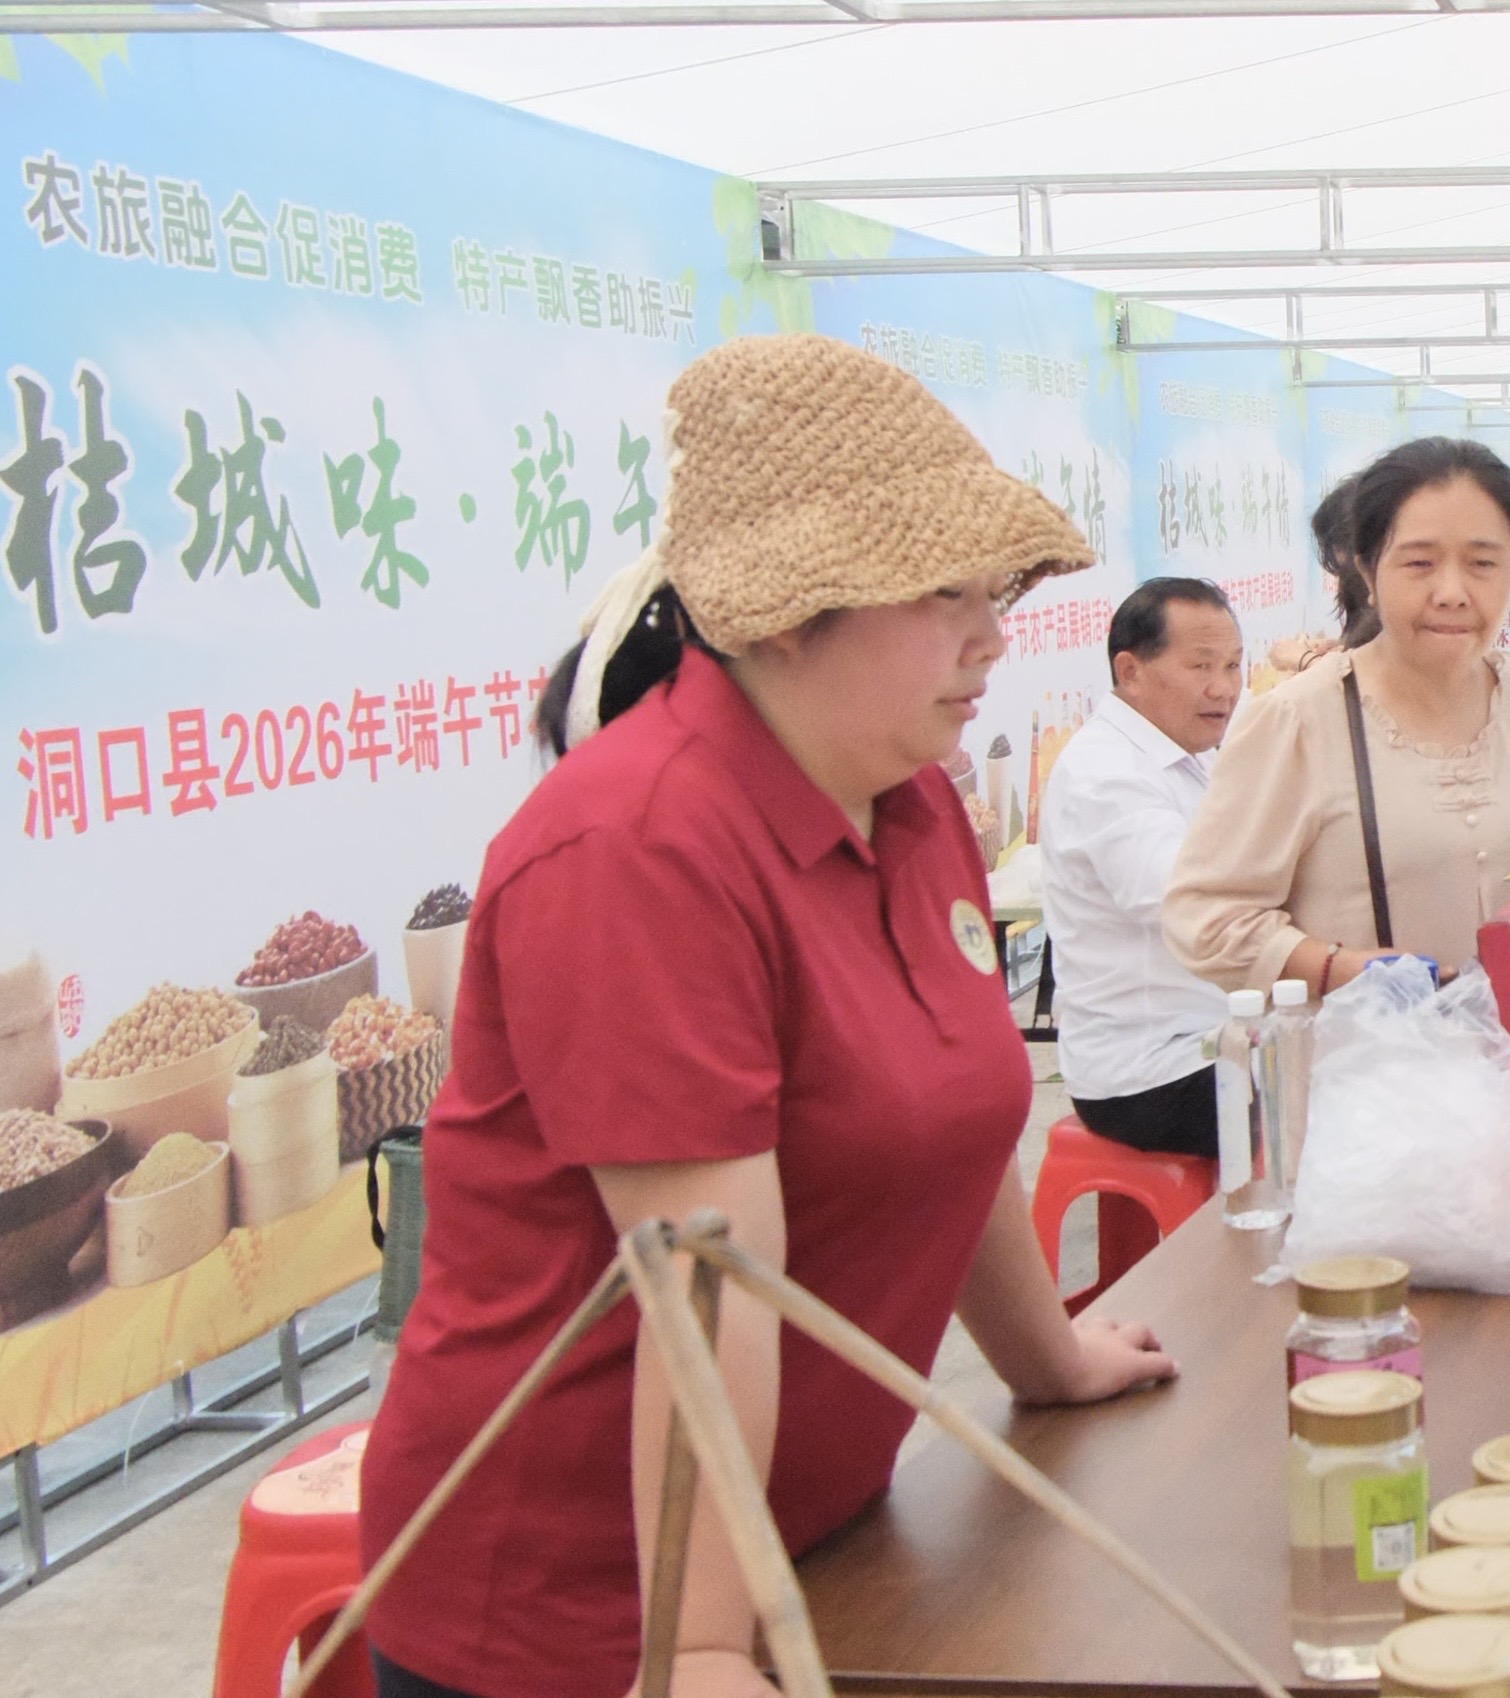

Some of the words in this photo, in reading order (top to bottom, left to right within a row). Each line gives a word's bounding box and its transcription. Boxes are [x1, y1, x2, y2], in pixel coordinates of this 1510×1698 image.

[24, 153, 423, 303] 农旅融合促消费
[453, 239, 696, 344] 特产飘香助振兴
